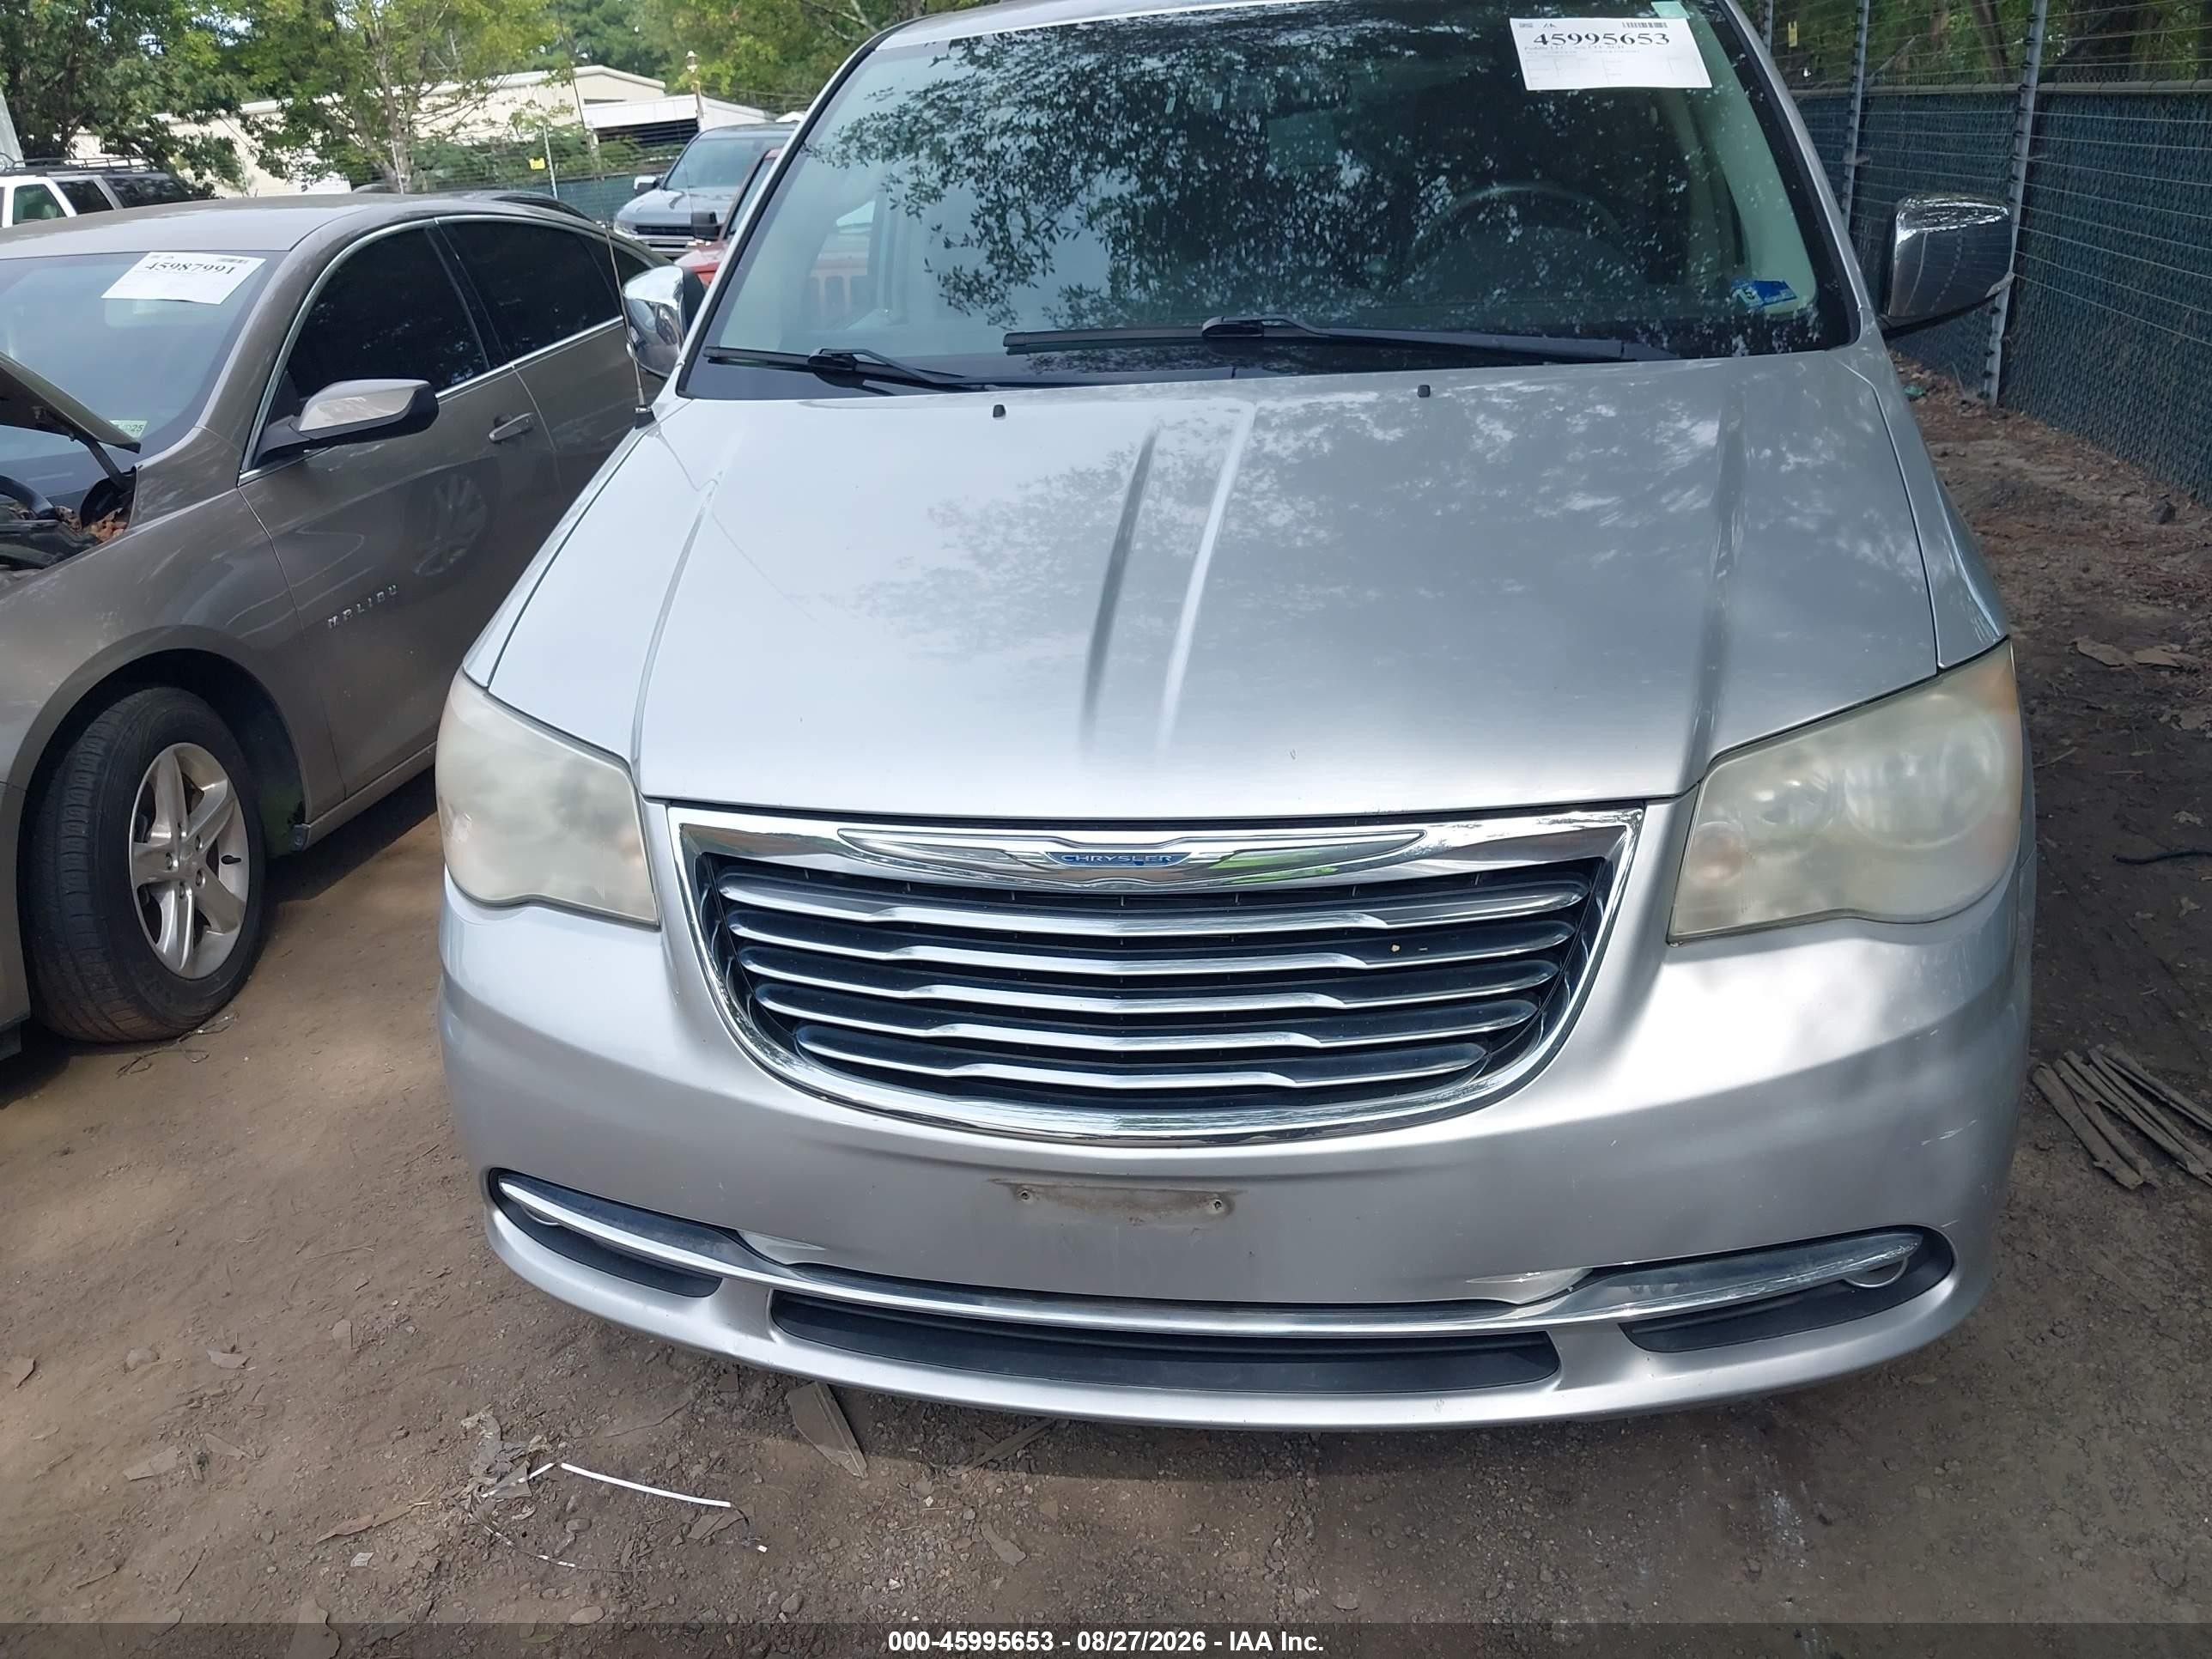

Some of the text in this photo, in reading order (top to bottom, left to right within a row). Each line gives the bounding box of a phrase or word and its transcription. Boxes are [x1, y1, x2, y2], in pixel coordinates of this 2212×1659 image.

[1533, 33, 1670, 46] 45995653
[144, 261, 238, 275] 45987991
[327, 584, 398, 629] MALIBU
[1060, 854, 1173, 863] CHRYSLER
